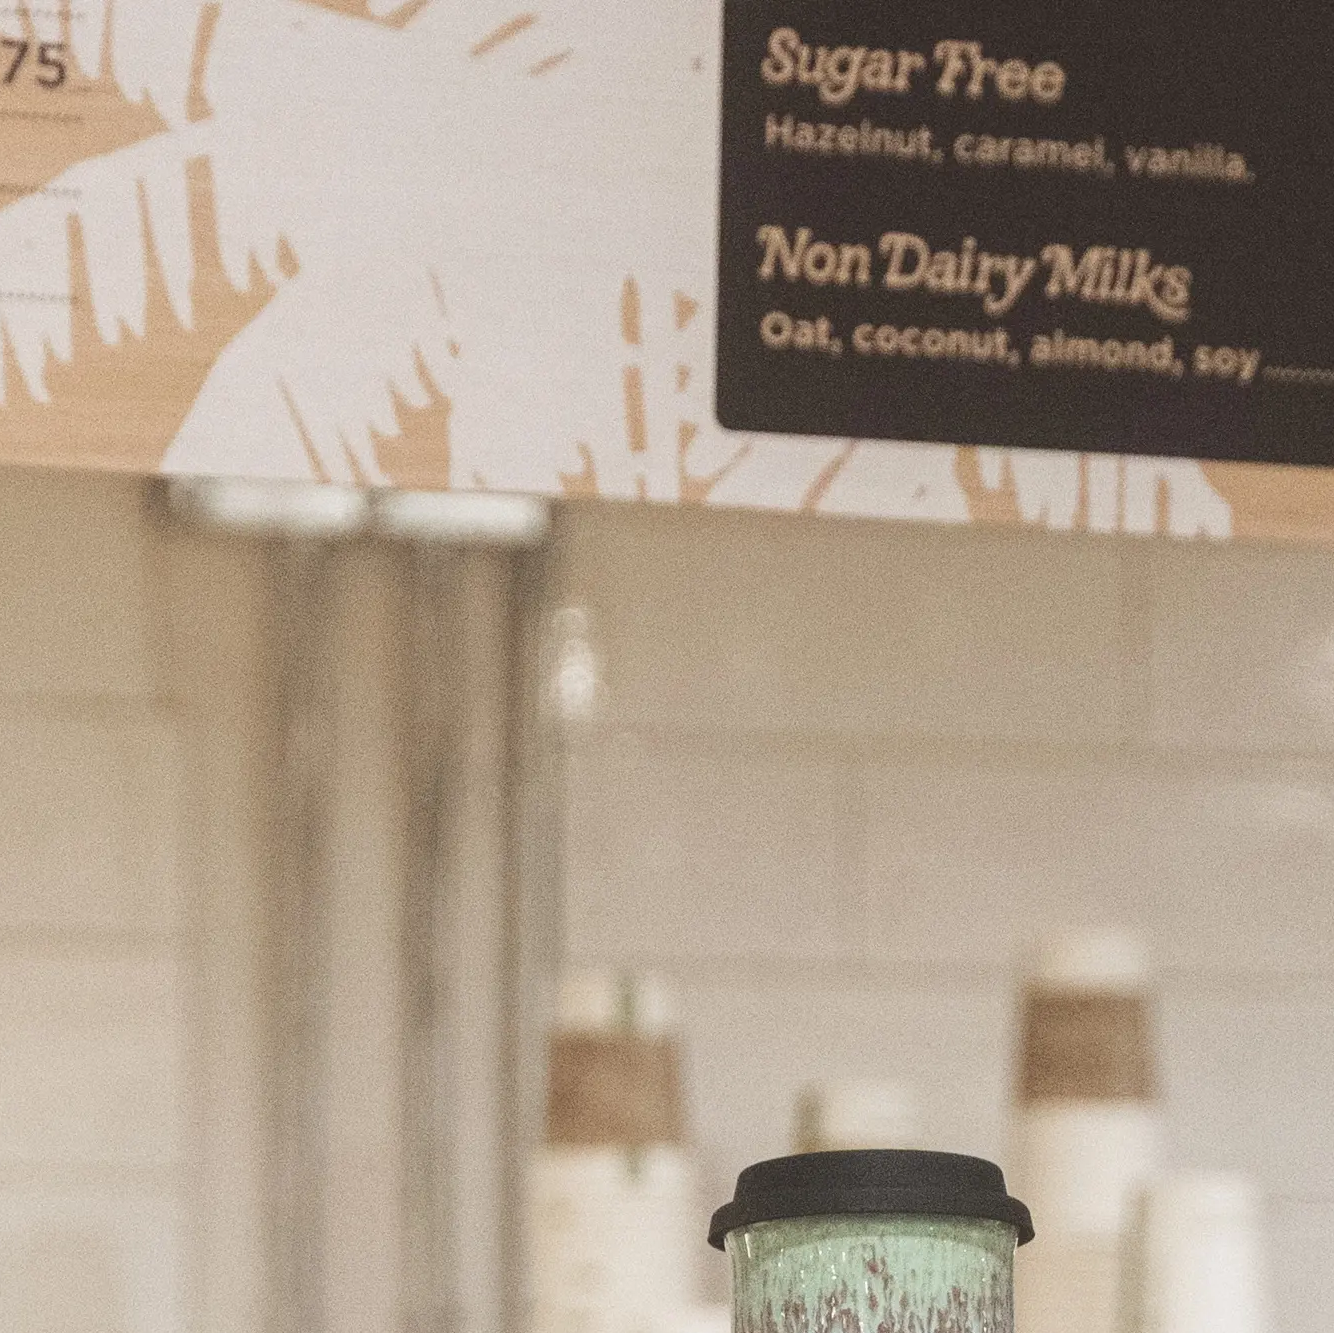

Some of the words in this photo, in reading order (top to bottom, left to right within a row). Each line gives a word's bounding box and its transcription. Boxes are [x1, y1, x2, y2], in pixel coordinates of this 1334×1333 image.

[761, 27, 925, 105] Sugar
[934, 40, 1066, 102] Free
[764, 114, 942, 162] Hazelnut,
[954, 134, 1113, 173] caramel,
[757, 225, 870, 285] Non
[879, 232, 1036, 314] Dairy
[1041, 244, 1190, 321] Milks
[760, 311, 841, 354] Oat,
[852, 324, 1019, 365] coconut,
[1030, 330, 1183, 376] almond,
